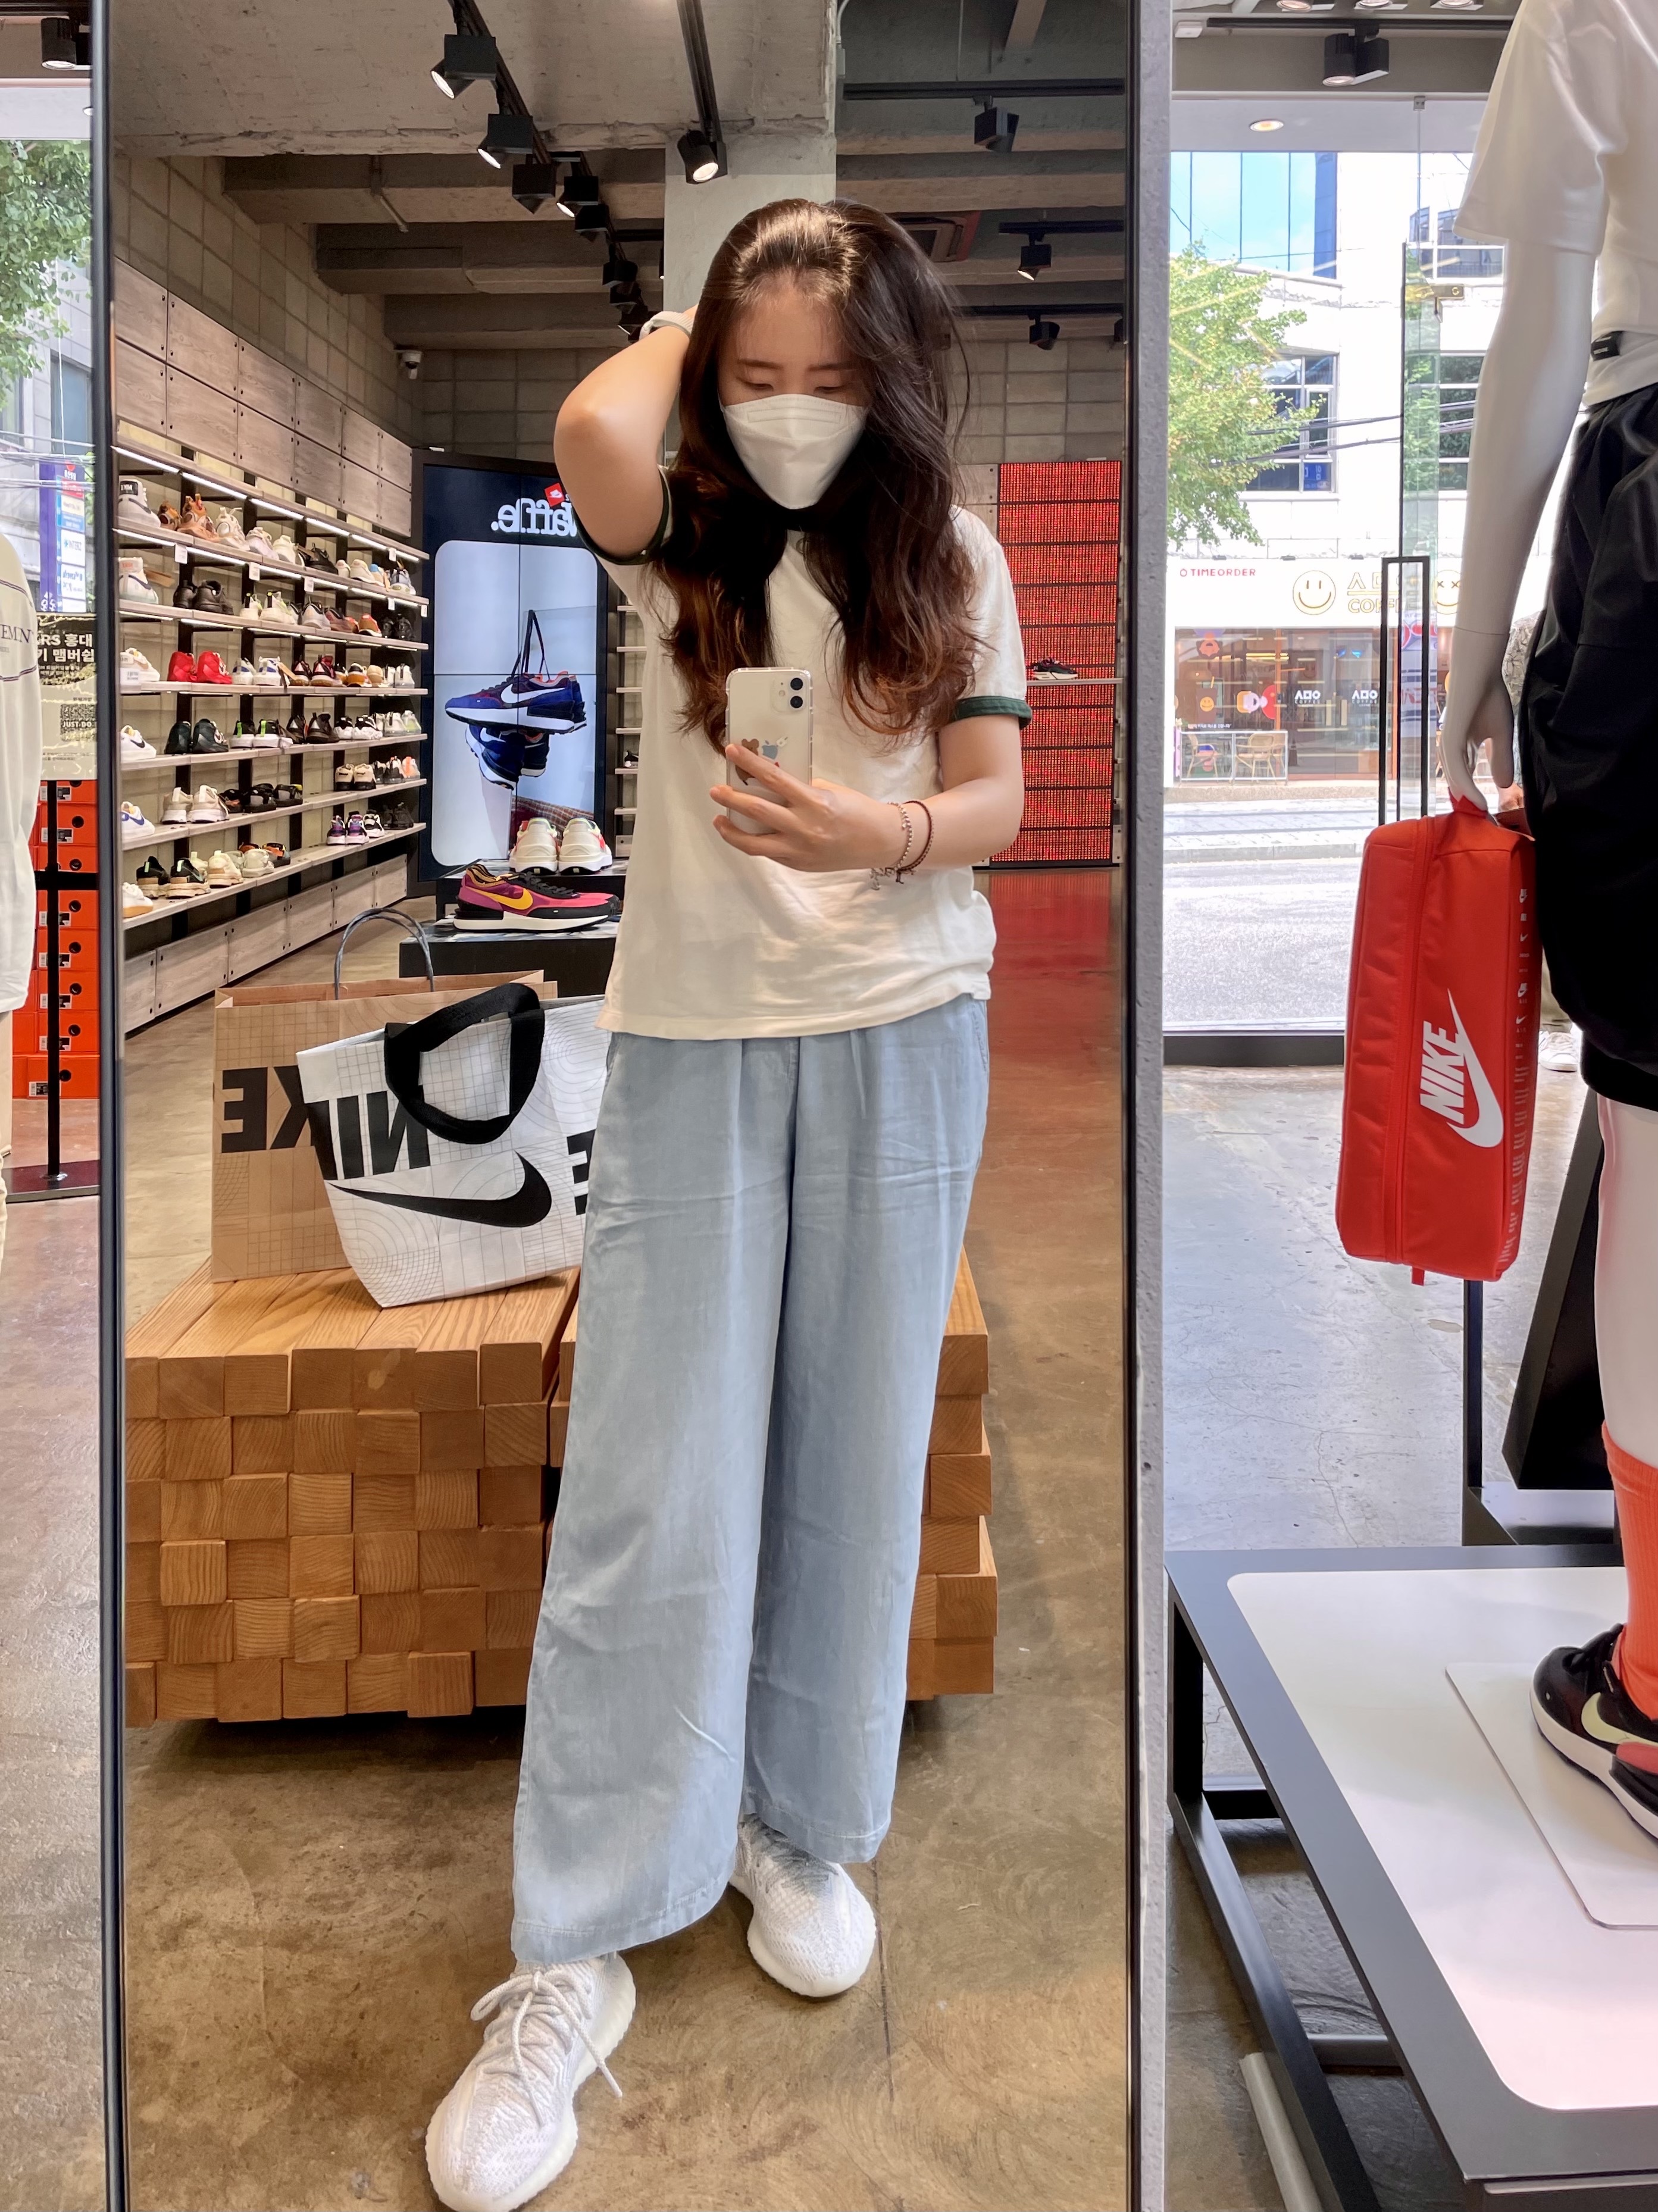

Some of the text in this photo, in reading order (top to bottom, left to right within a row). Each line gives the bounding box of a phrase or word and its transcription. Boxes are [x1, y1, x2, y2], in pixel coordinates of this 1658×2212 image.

[1190, 568, 1256, 577] TIMEORDER
[64, 634, 93, 647] 홍대
[1419, 1020, 1465, 1125] NIKE
